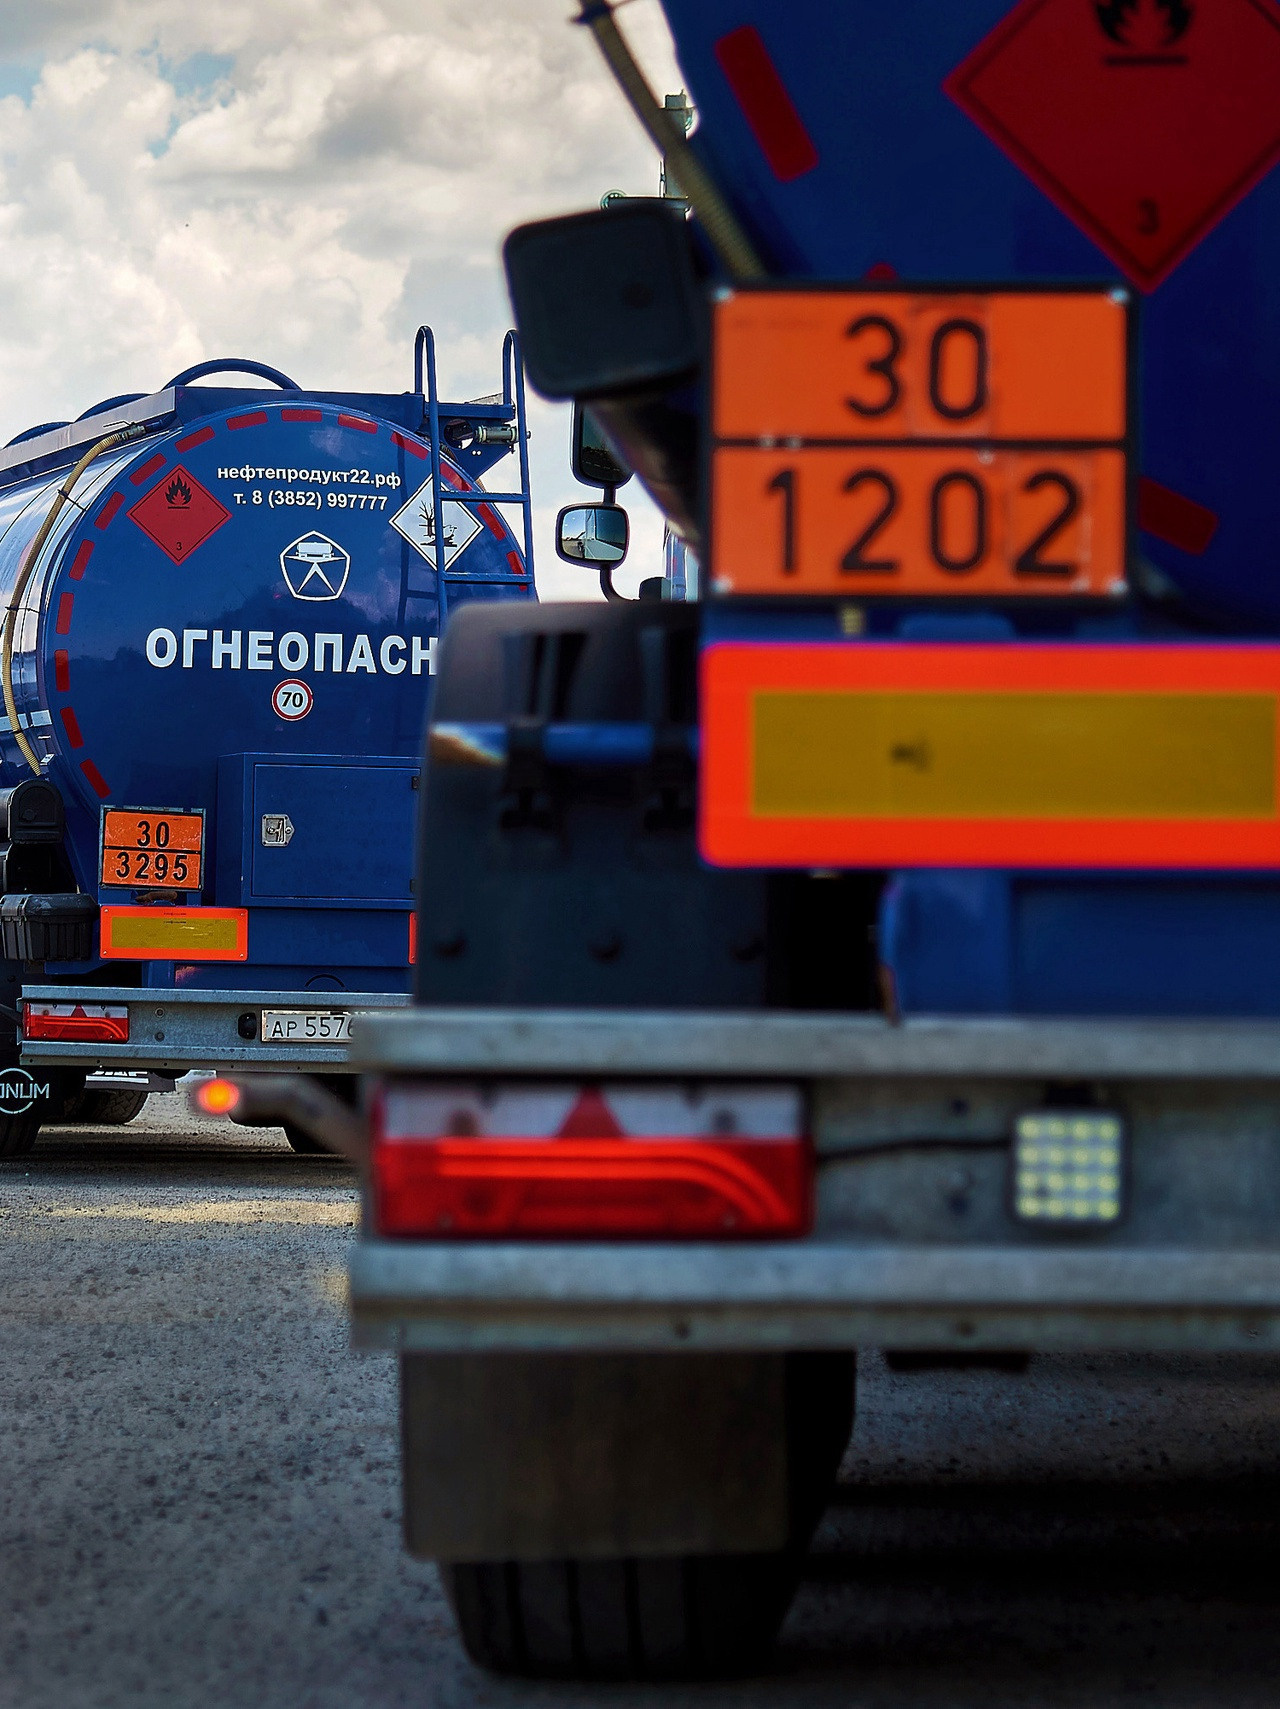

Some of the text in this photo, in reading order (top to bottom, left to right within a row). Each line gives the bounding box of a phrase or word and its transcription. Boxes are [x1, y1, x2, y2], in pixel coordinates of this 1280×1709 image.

[843, 314, 988, 421] 30
[217, 464, 402, 490] нефтепродукт22.рф
[233, 490, 388, 511] т. 8 (3852) 997777
[766, 468, 1080, 576] 1202
[176, 541, 182, 551] 3
[281, 691, 304, 708] 70
[137, 820, 170, 848] 30
[116, 852, 189, 882] 3295
[272, 1020, 298, 1038] АР
